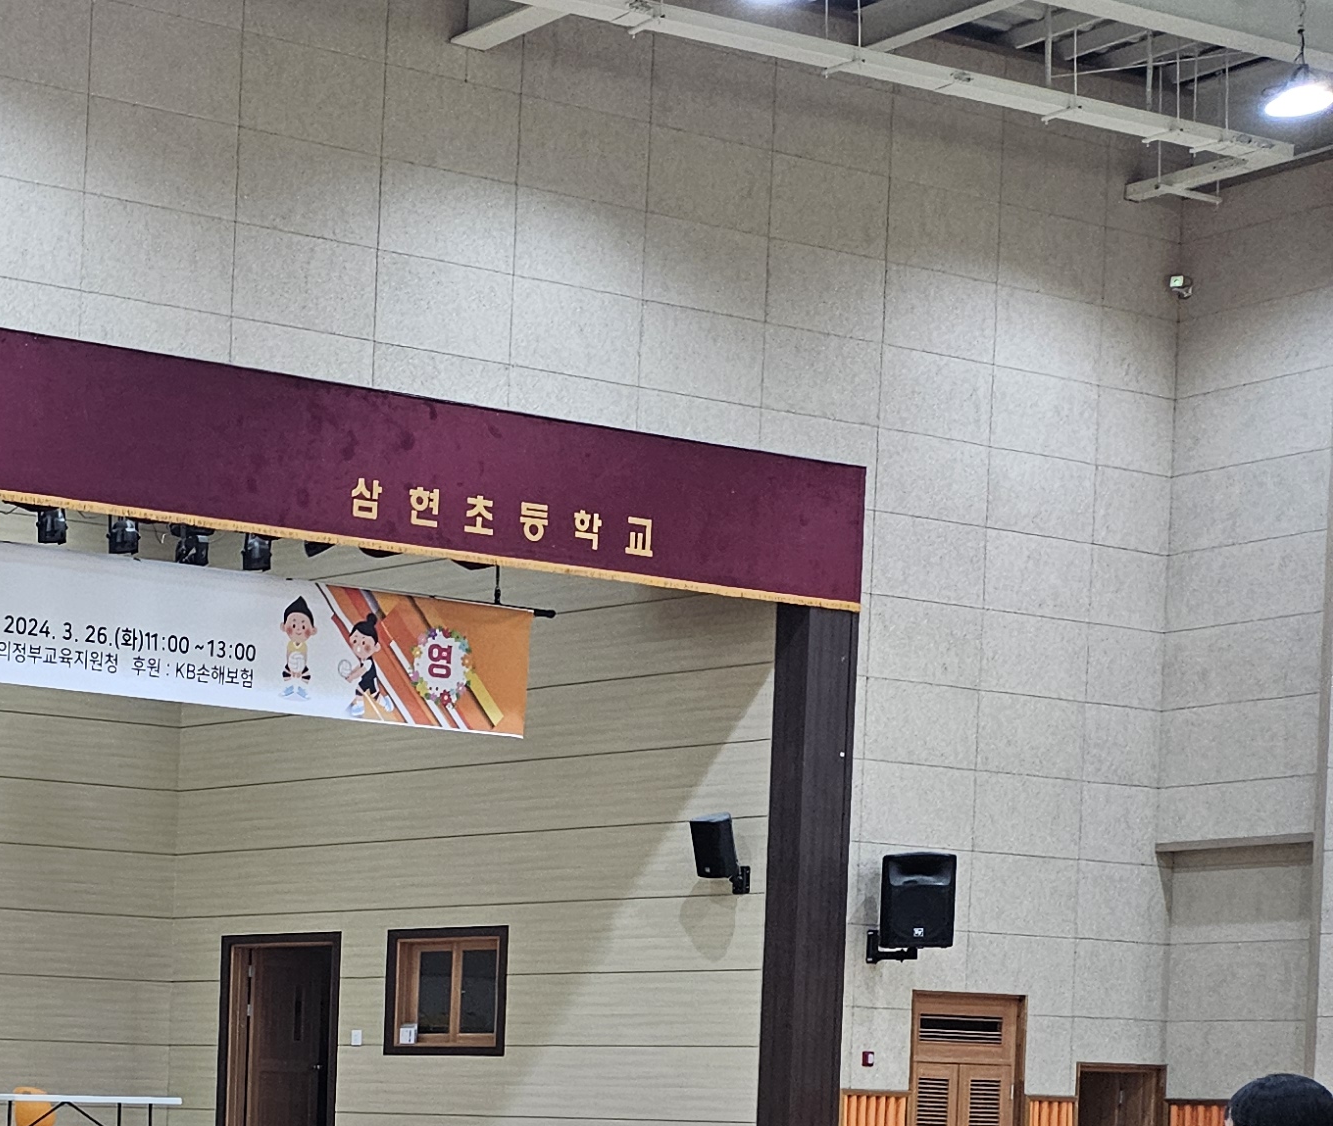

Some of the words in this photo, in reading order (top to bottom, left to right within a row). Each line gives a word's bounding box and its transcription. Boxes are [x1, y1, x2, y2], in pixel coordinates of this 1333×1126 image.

[4, 615, 55, 640] 2024.
[131, 655, 161, 677] 후원
[175, 662, 253, 689] KB손해보험
[427, 643, 454, 679] 영
